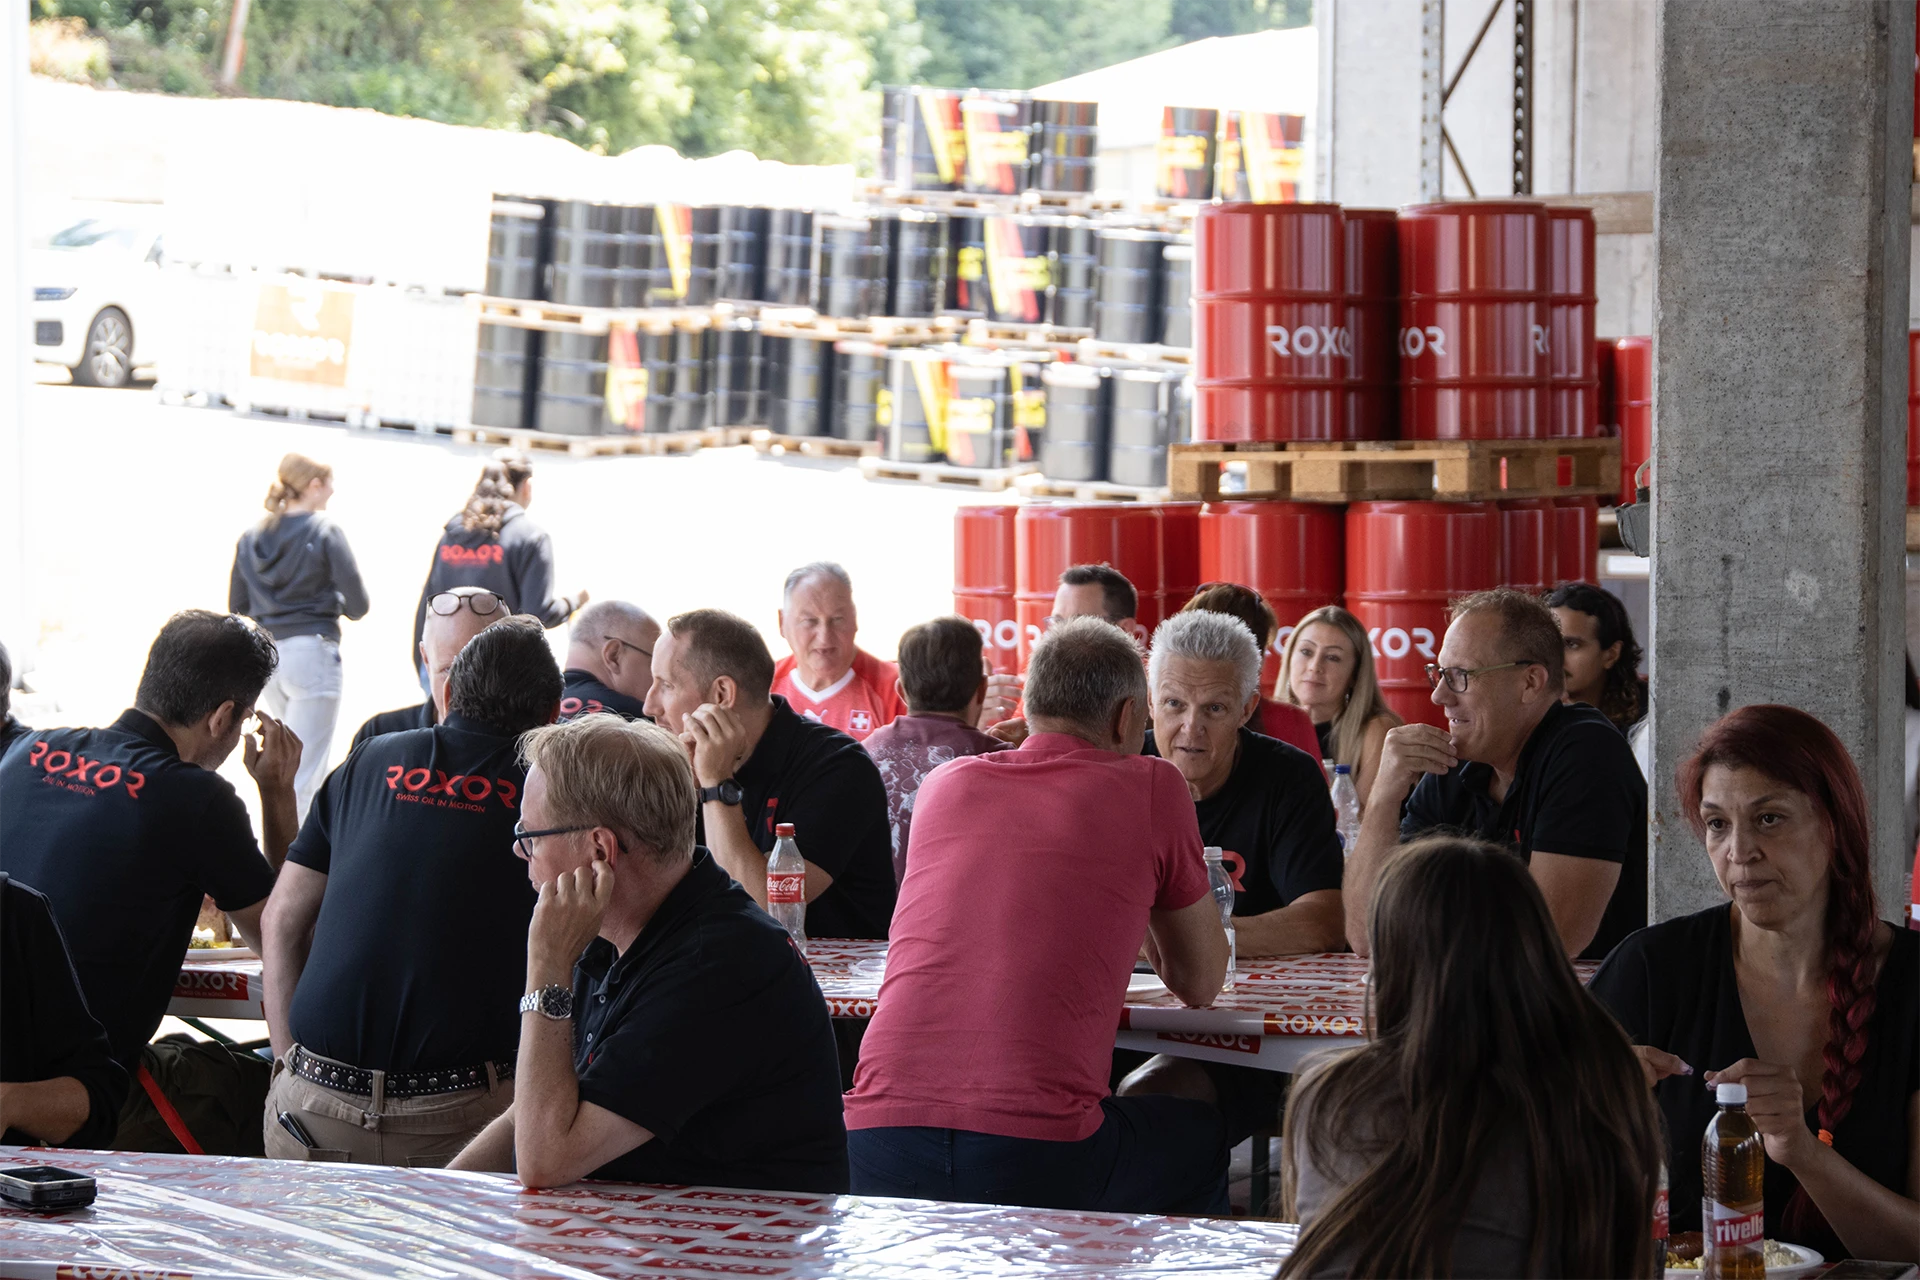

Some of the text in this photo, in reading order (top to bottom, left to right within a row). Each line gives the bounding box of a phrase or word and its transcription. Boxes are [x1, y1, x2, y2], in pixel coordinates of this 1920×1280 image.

[29, 740, 146, 799] ROXOR
[67, 784, 97, 797] MOTION
[386, 765, 517, 809] ROXOR
[395, 793, 486, 813] SWISS OIL IN MOTION
[1275, 1014, 1364, 1035] ROXOR
